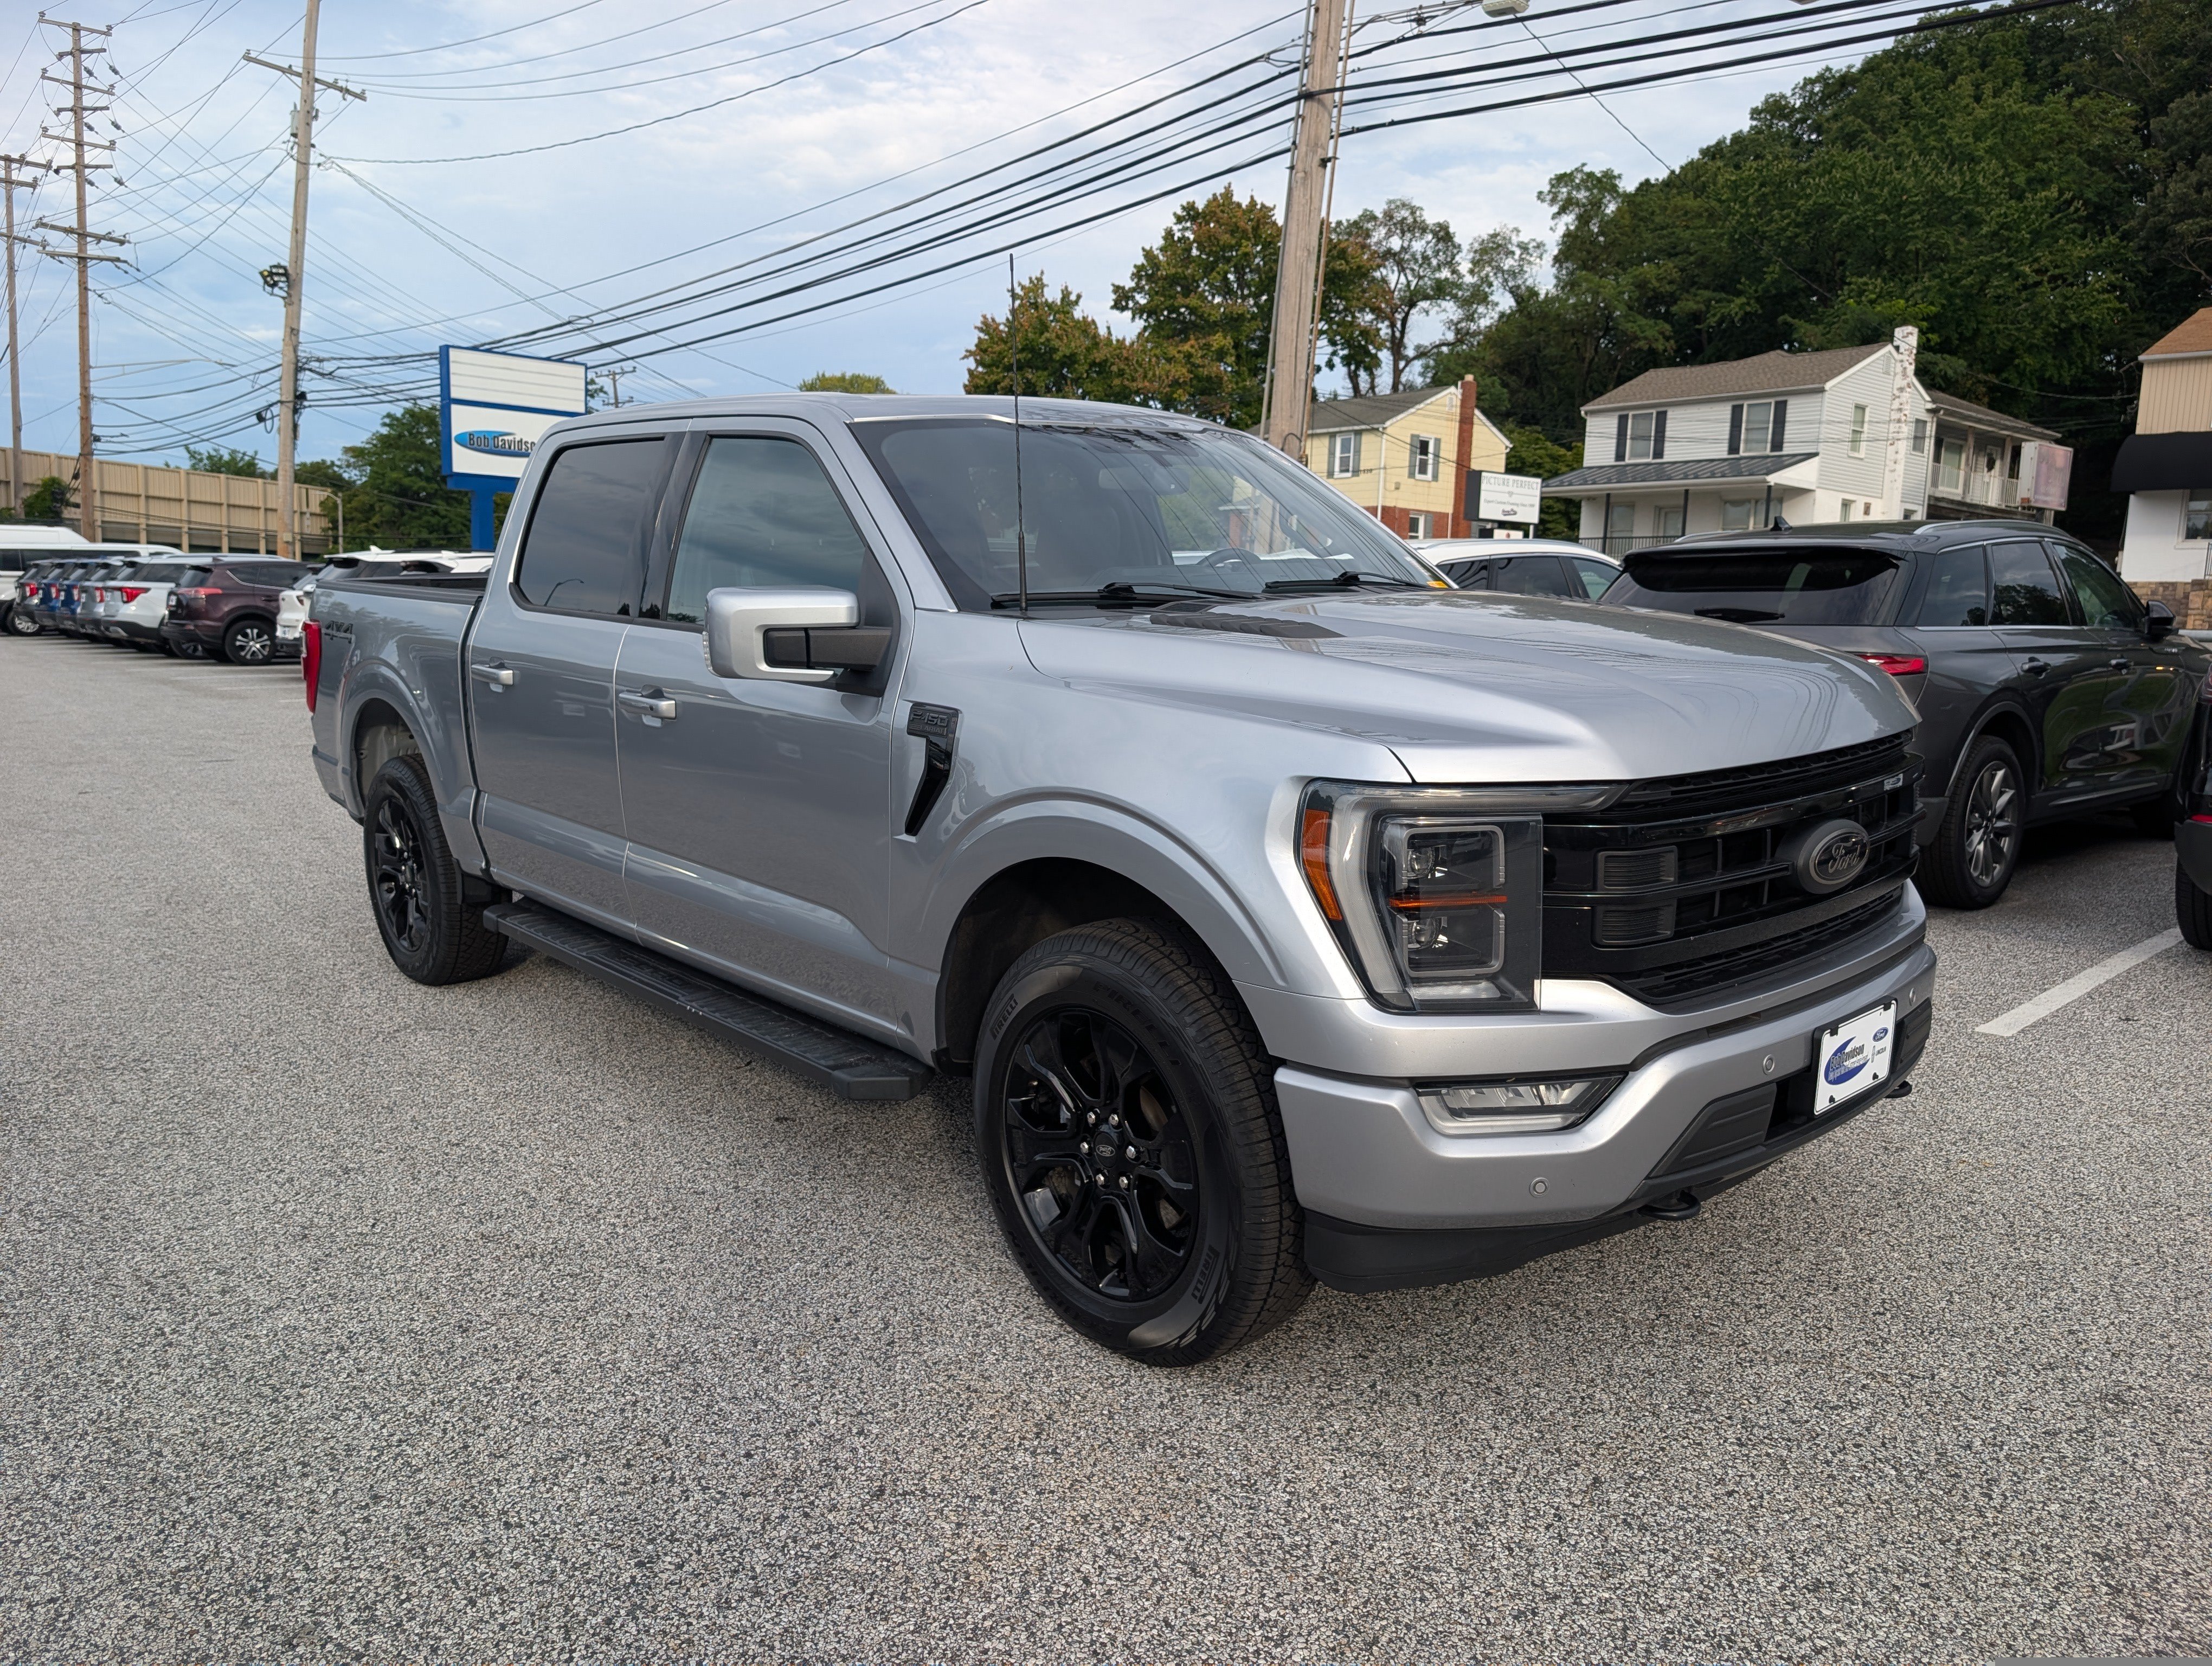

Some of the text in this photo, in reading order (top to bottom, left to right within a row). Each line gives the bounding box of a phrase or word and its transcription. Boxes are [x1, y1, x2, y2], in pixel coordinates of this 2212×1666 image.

[468, 433, 490, 448] Bob
[1482, 475, 1540, 490] PICTURE PERFECT
[910, 710, 949, 727] F-150
[920, 725, 948, 735] LARIAT
[1828, 841, 1861, 874] Ford
[990, 993, 1018, 1041] PIRELLI
[1092, 981, 1183, 1066] PIRELLI
[1830, 1052, 1842, 1069] Bob
[1842, 1043, 1864, 1064] Davidson
[1191, 1244, 1220, 1304] PIRELLI
